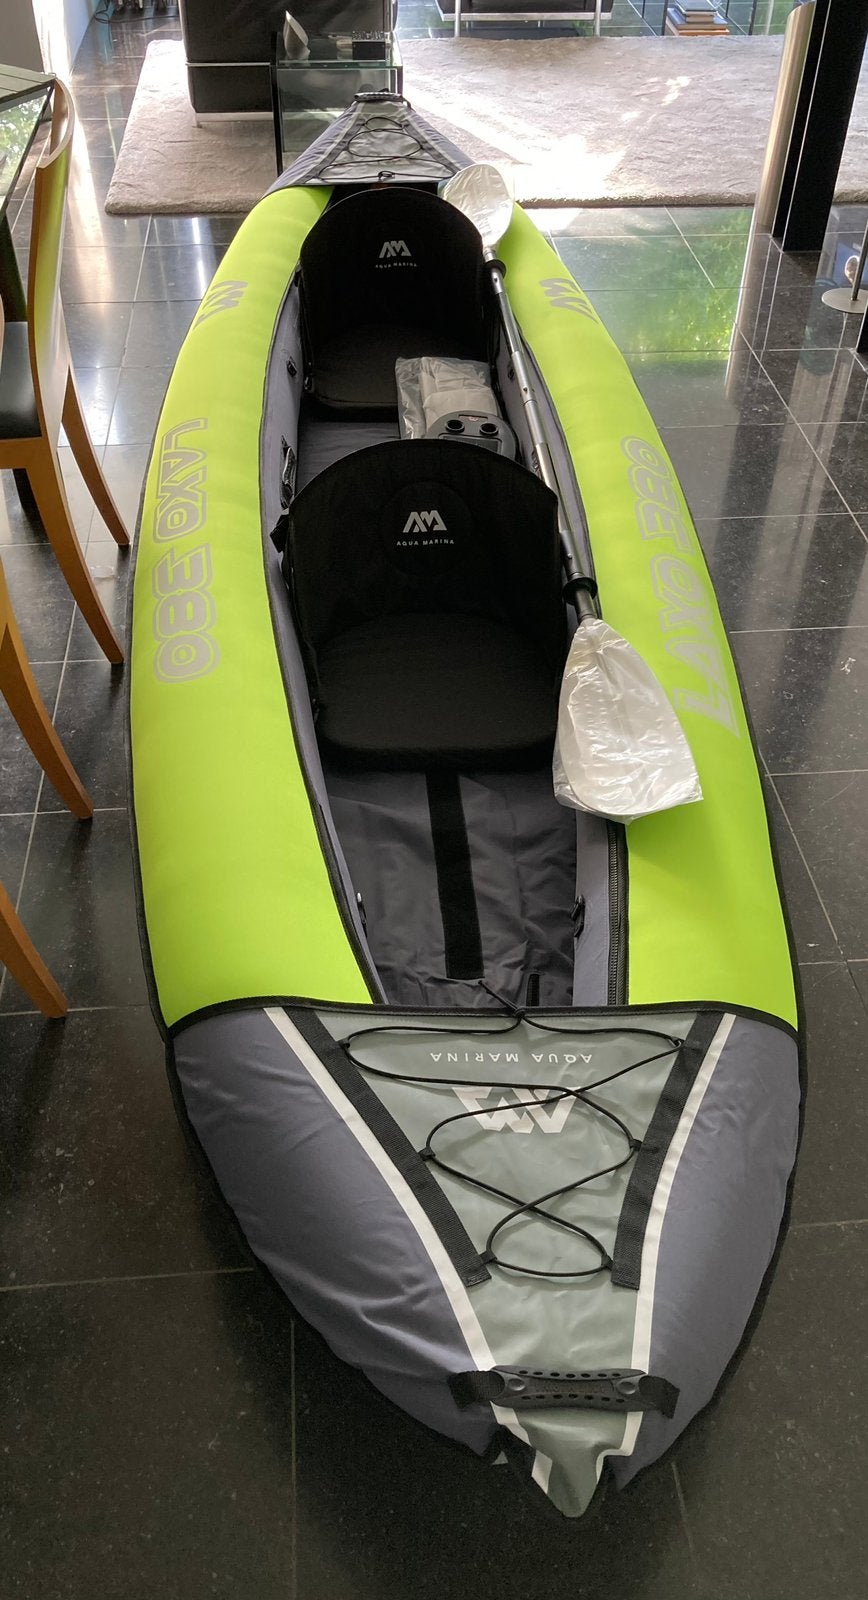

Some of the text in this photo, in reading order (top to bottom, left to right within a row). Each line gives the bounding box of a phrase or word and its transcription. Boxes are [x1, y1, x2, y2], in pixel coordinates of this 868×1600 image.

[151, 418, 220, 684] LAXO 380
[620, 436, 741, 739] LAXO 380
[429, 1052, 593, 1064] AQUA MARINA
